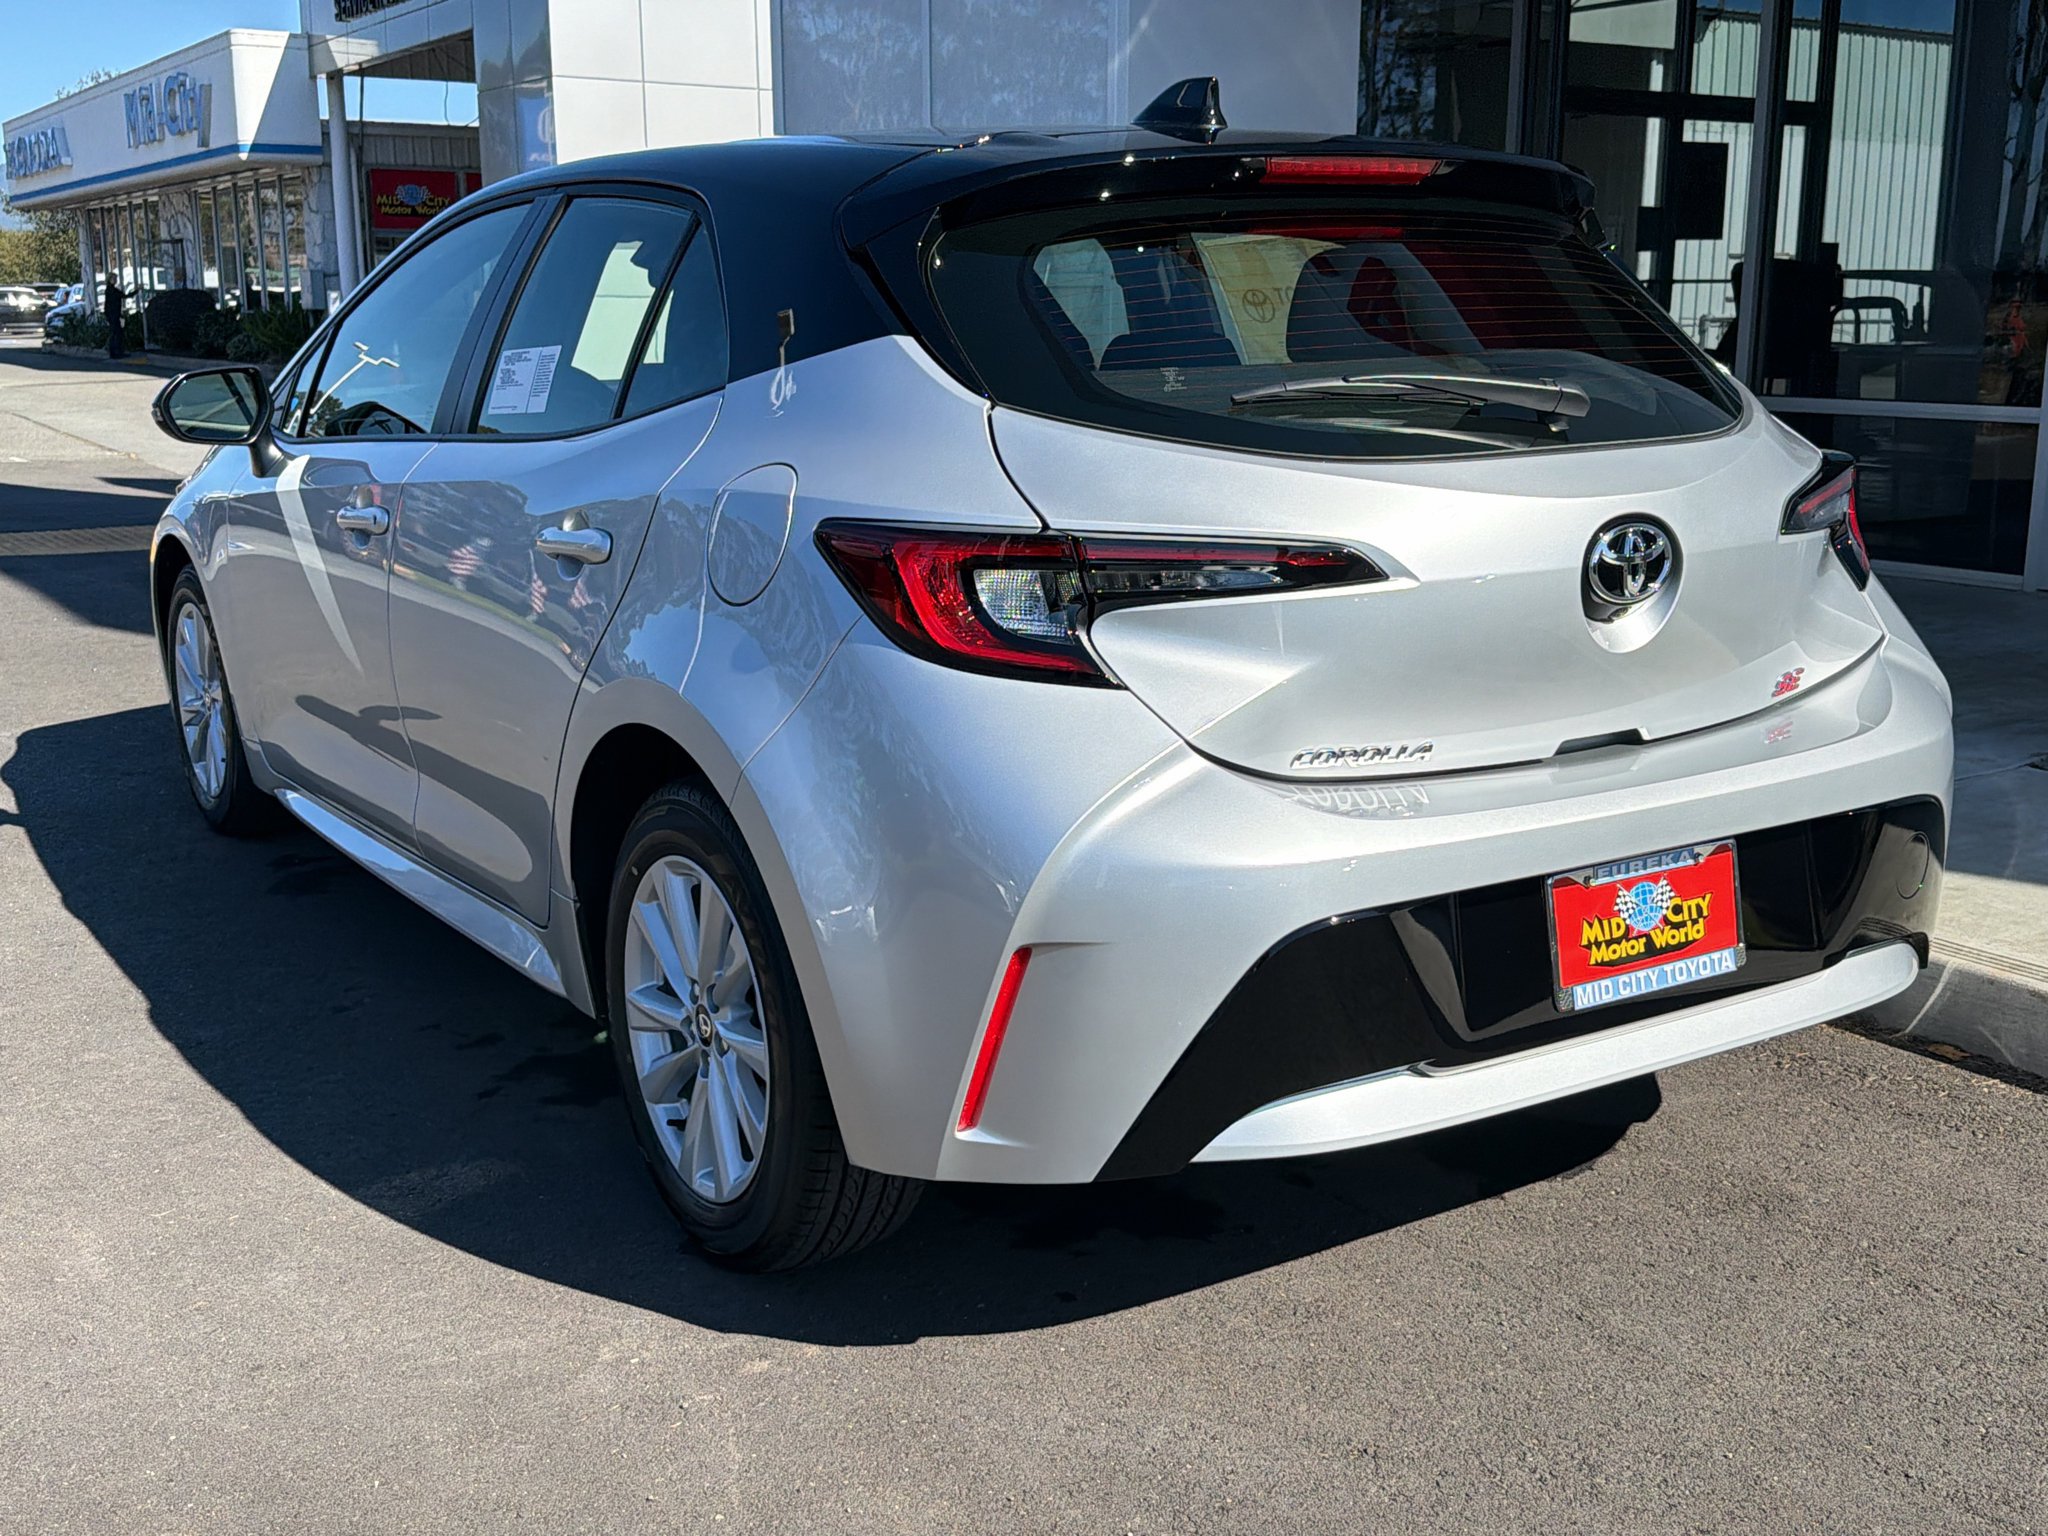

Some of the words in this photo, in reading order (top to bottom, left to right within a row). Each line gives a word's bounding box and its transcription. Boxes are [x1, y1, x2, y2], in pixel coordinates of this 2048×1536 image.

[376, 194, 401, 205] MID
[425, 195, 450, 206] CITY
[381, 205, 412, 215] Motor
[1290, 739, 1433, 769] COROLLA
[1596, 850, 1690, 879] EUREKA
[1581, 917, 1626, 946] MID
[1667, 892, 1713, 923] CITY
[1589, 937, 1646, 966] Motor
[1649, 919, 1706, 950] World
[1576, 980, 1613, 1007] MID
[1618, 969, 1660, 996] CITY
[1664, 951, 1734, 985] TOYOTA
